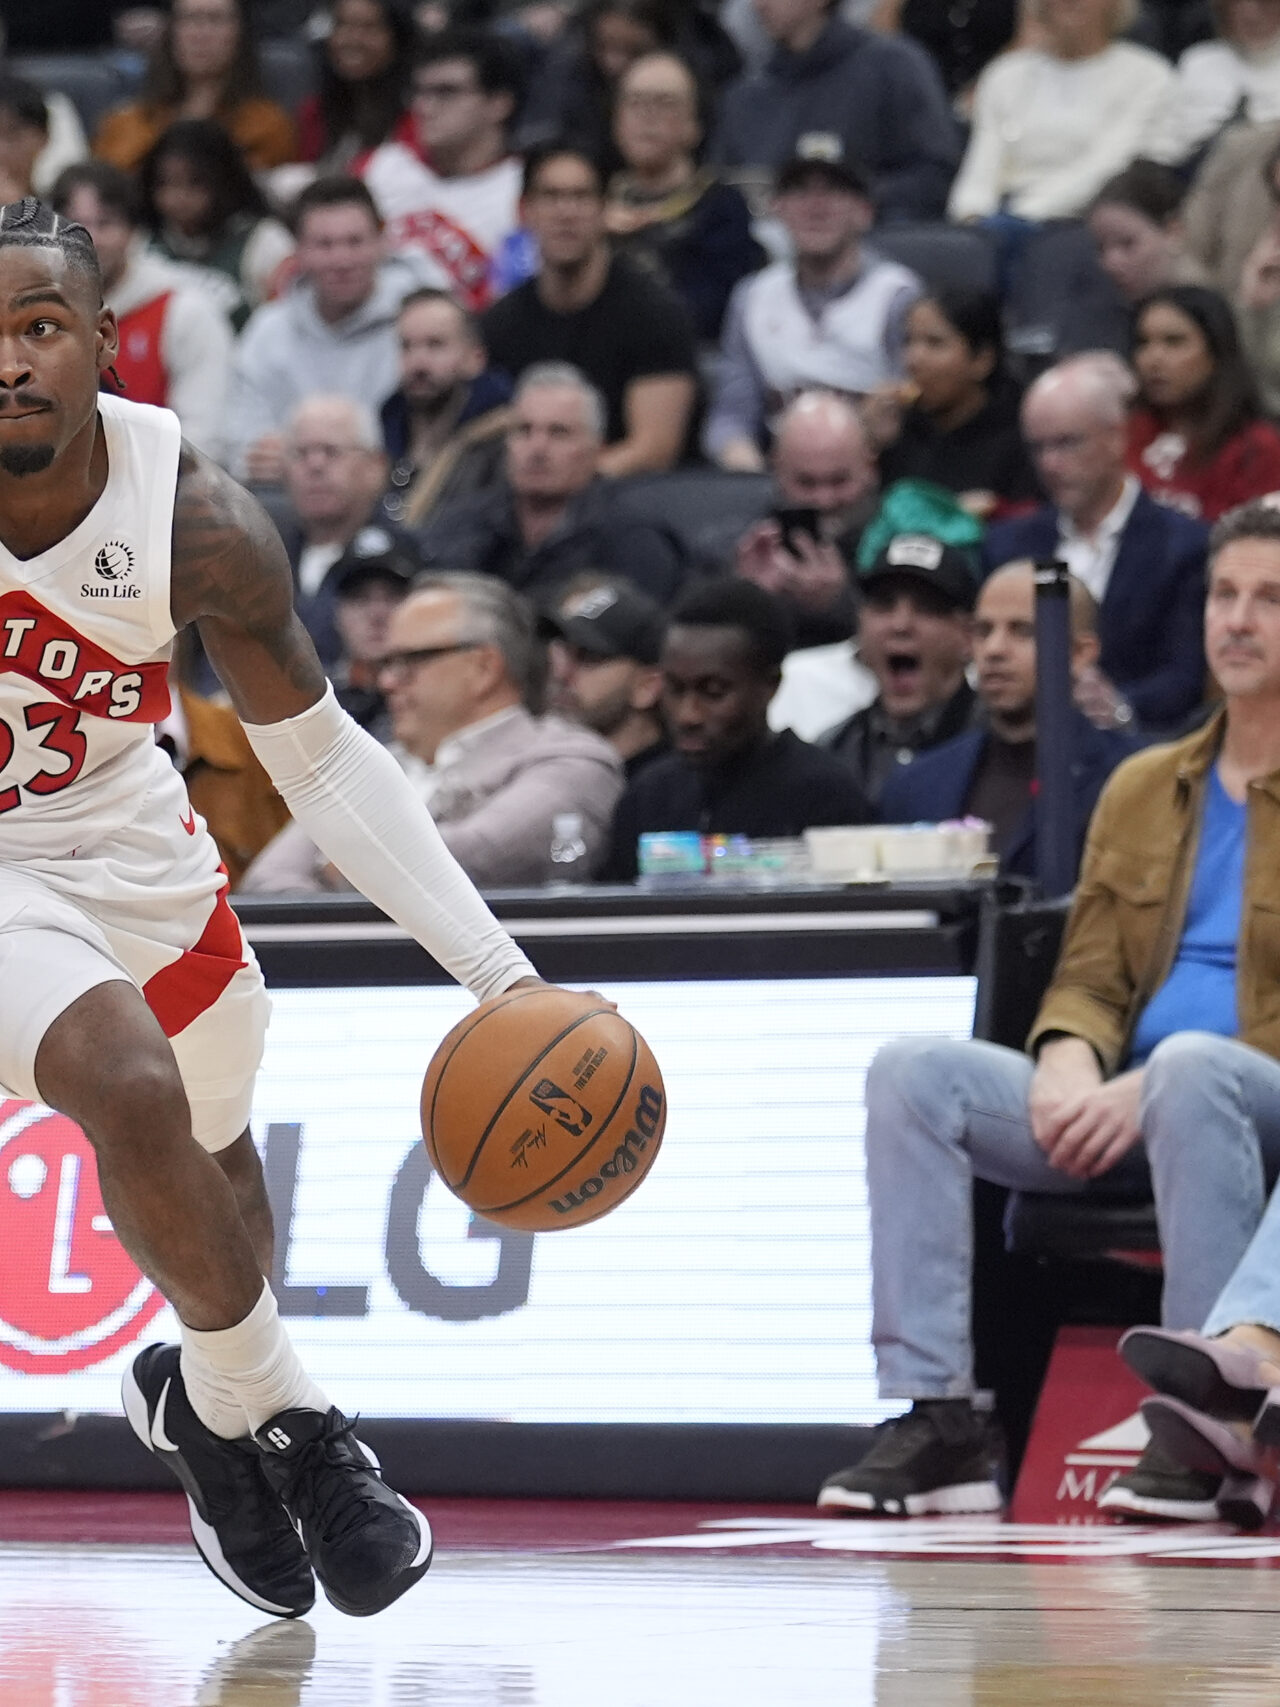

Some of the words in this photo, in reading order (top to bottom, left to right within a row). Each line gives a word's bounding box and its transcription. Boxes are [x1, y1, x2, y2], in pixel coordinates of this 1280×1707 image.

[80, 583, 109, 597] Sun
[113, 584, 141, 598] Life
[548, 1084, 663, 1214] Wilson
[265, 1122, 534, 1321] LG
